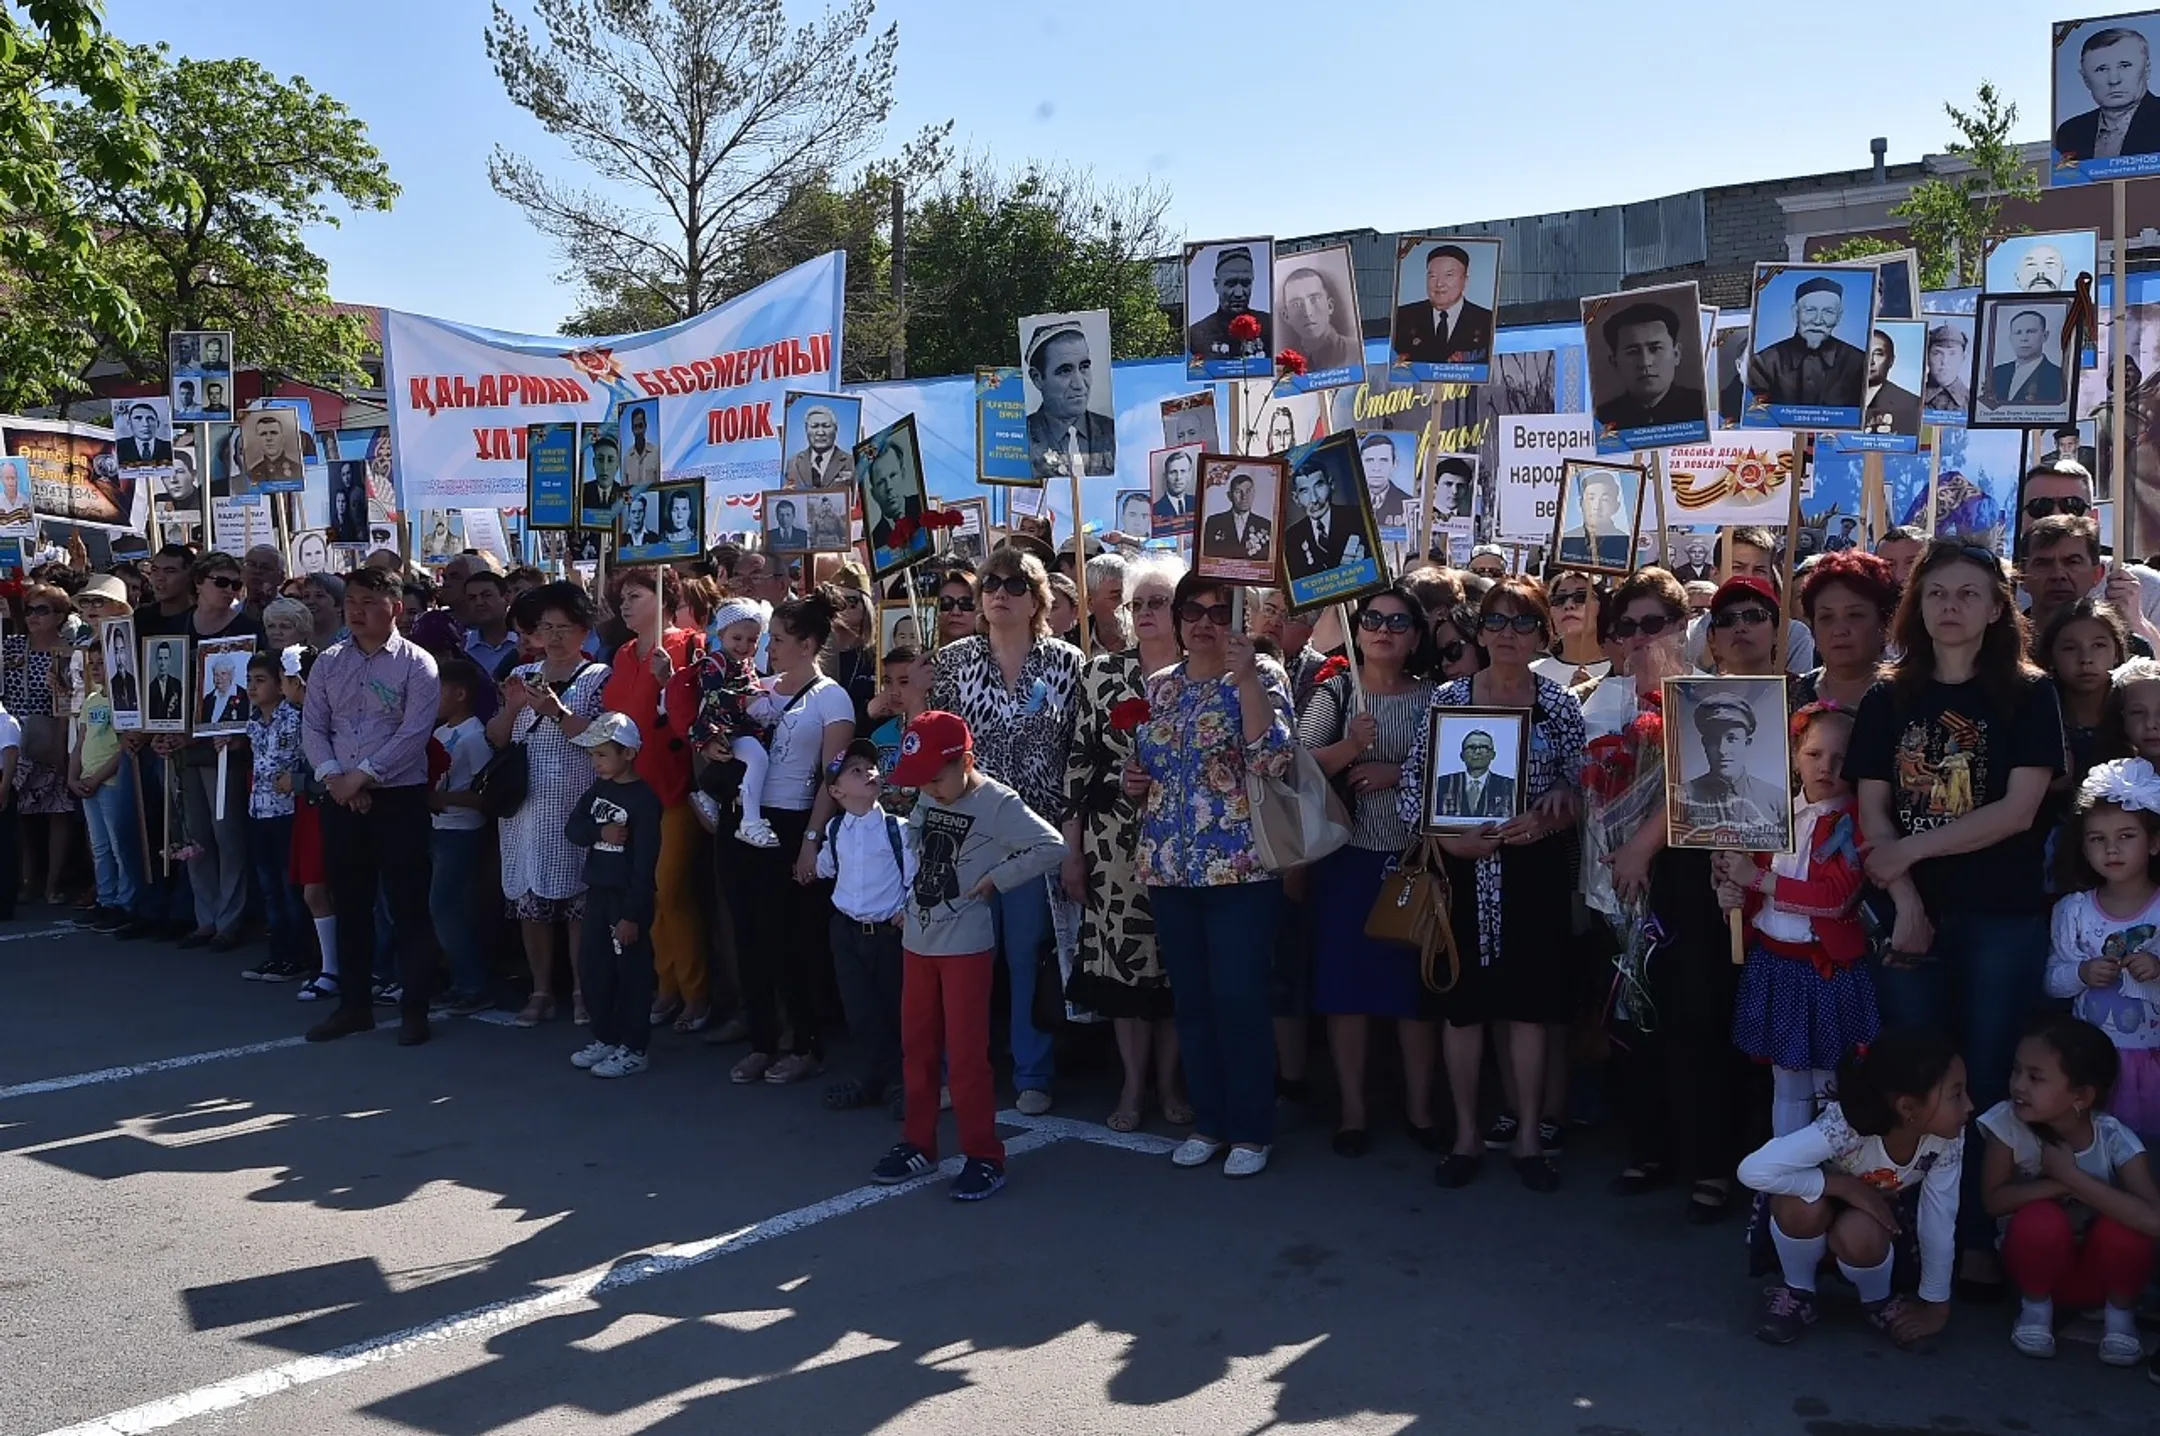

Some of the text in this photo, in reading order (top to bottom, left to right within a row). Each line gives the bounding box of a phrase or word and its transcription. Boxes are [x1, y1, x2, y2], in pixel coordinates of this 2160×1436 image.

[409, 373, 591, 417] ҚАҺАРМАН
[707, 401, 775, 446] ПОЛК
[1670, 447, 1745, 458] СПАСИБО ДЕДУ
[1669, 460, 1681, 469] ЗА
[34, 484, 99, 500] 1941-1945
[928, 810, 969, 829] DEFEND
